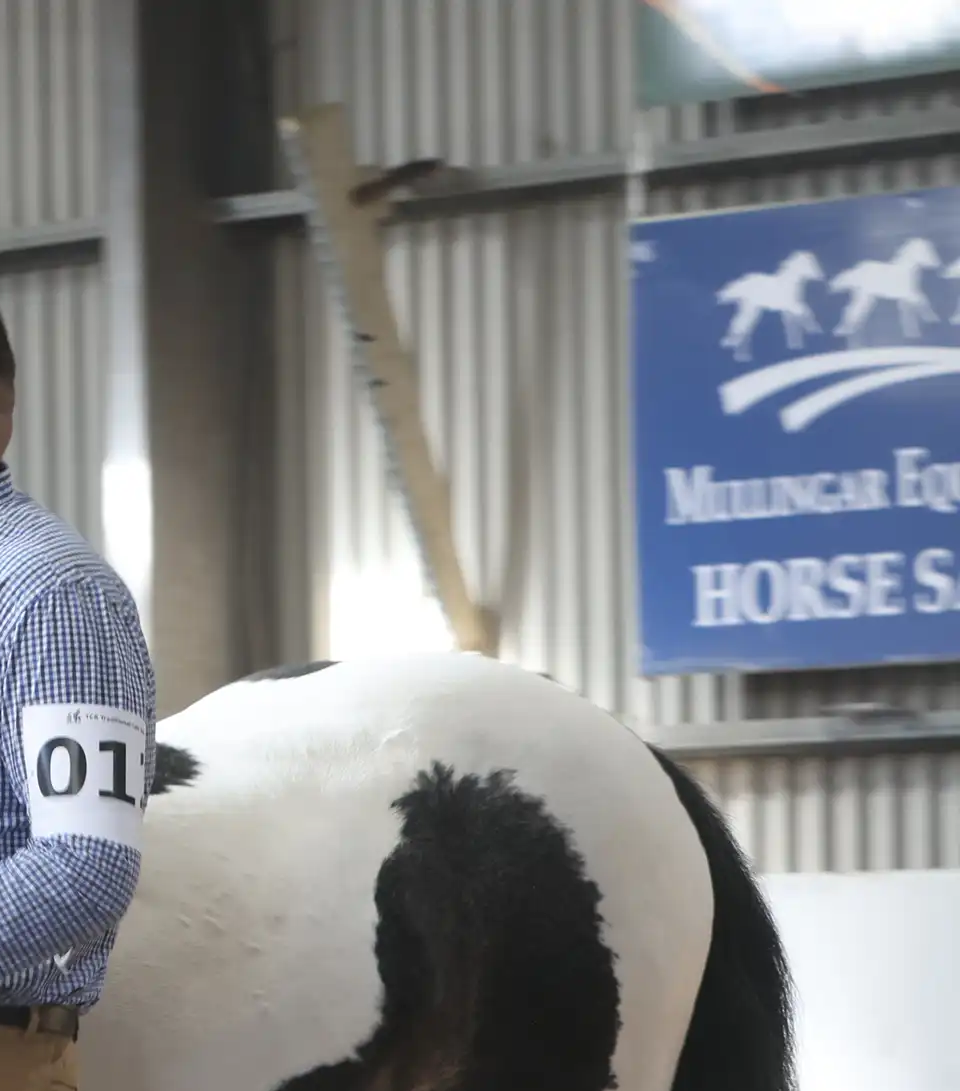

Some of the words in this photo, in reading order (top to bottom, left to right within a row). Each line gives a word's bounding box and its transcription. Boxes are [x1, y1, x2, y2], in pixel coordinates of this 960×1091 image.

[689, 552, 906, 627] HORSE
[912, 548, 960, 613] S
[37, 736, 144, 807] 01
